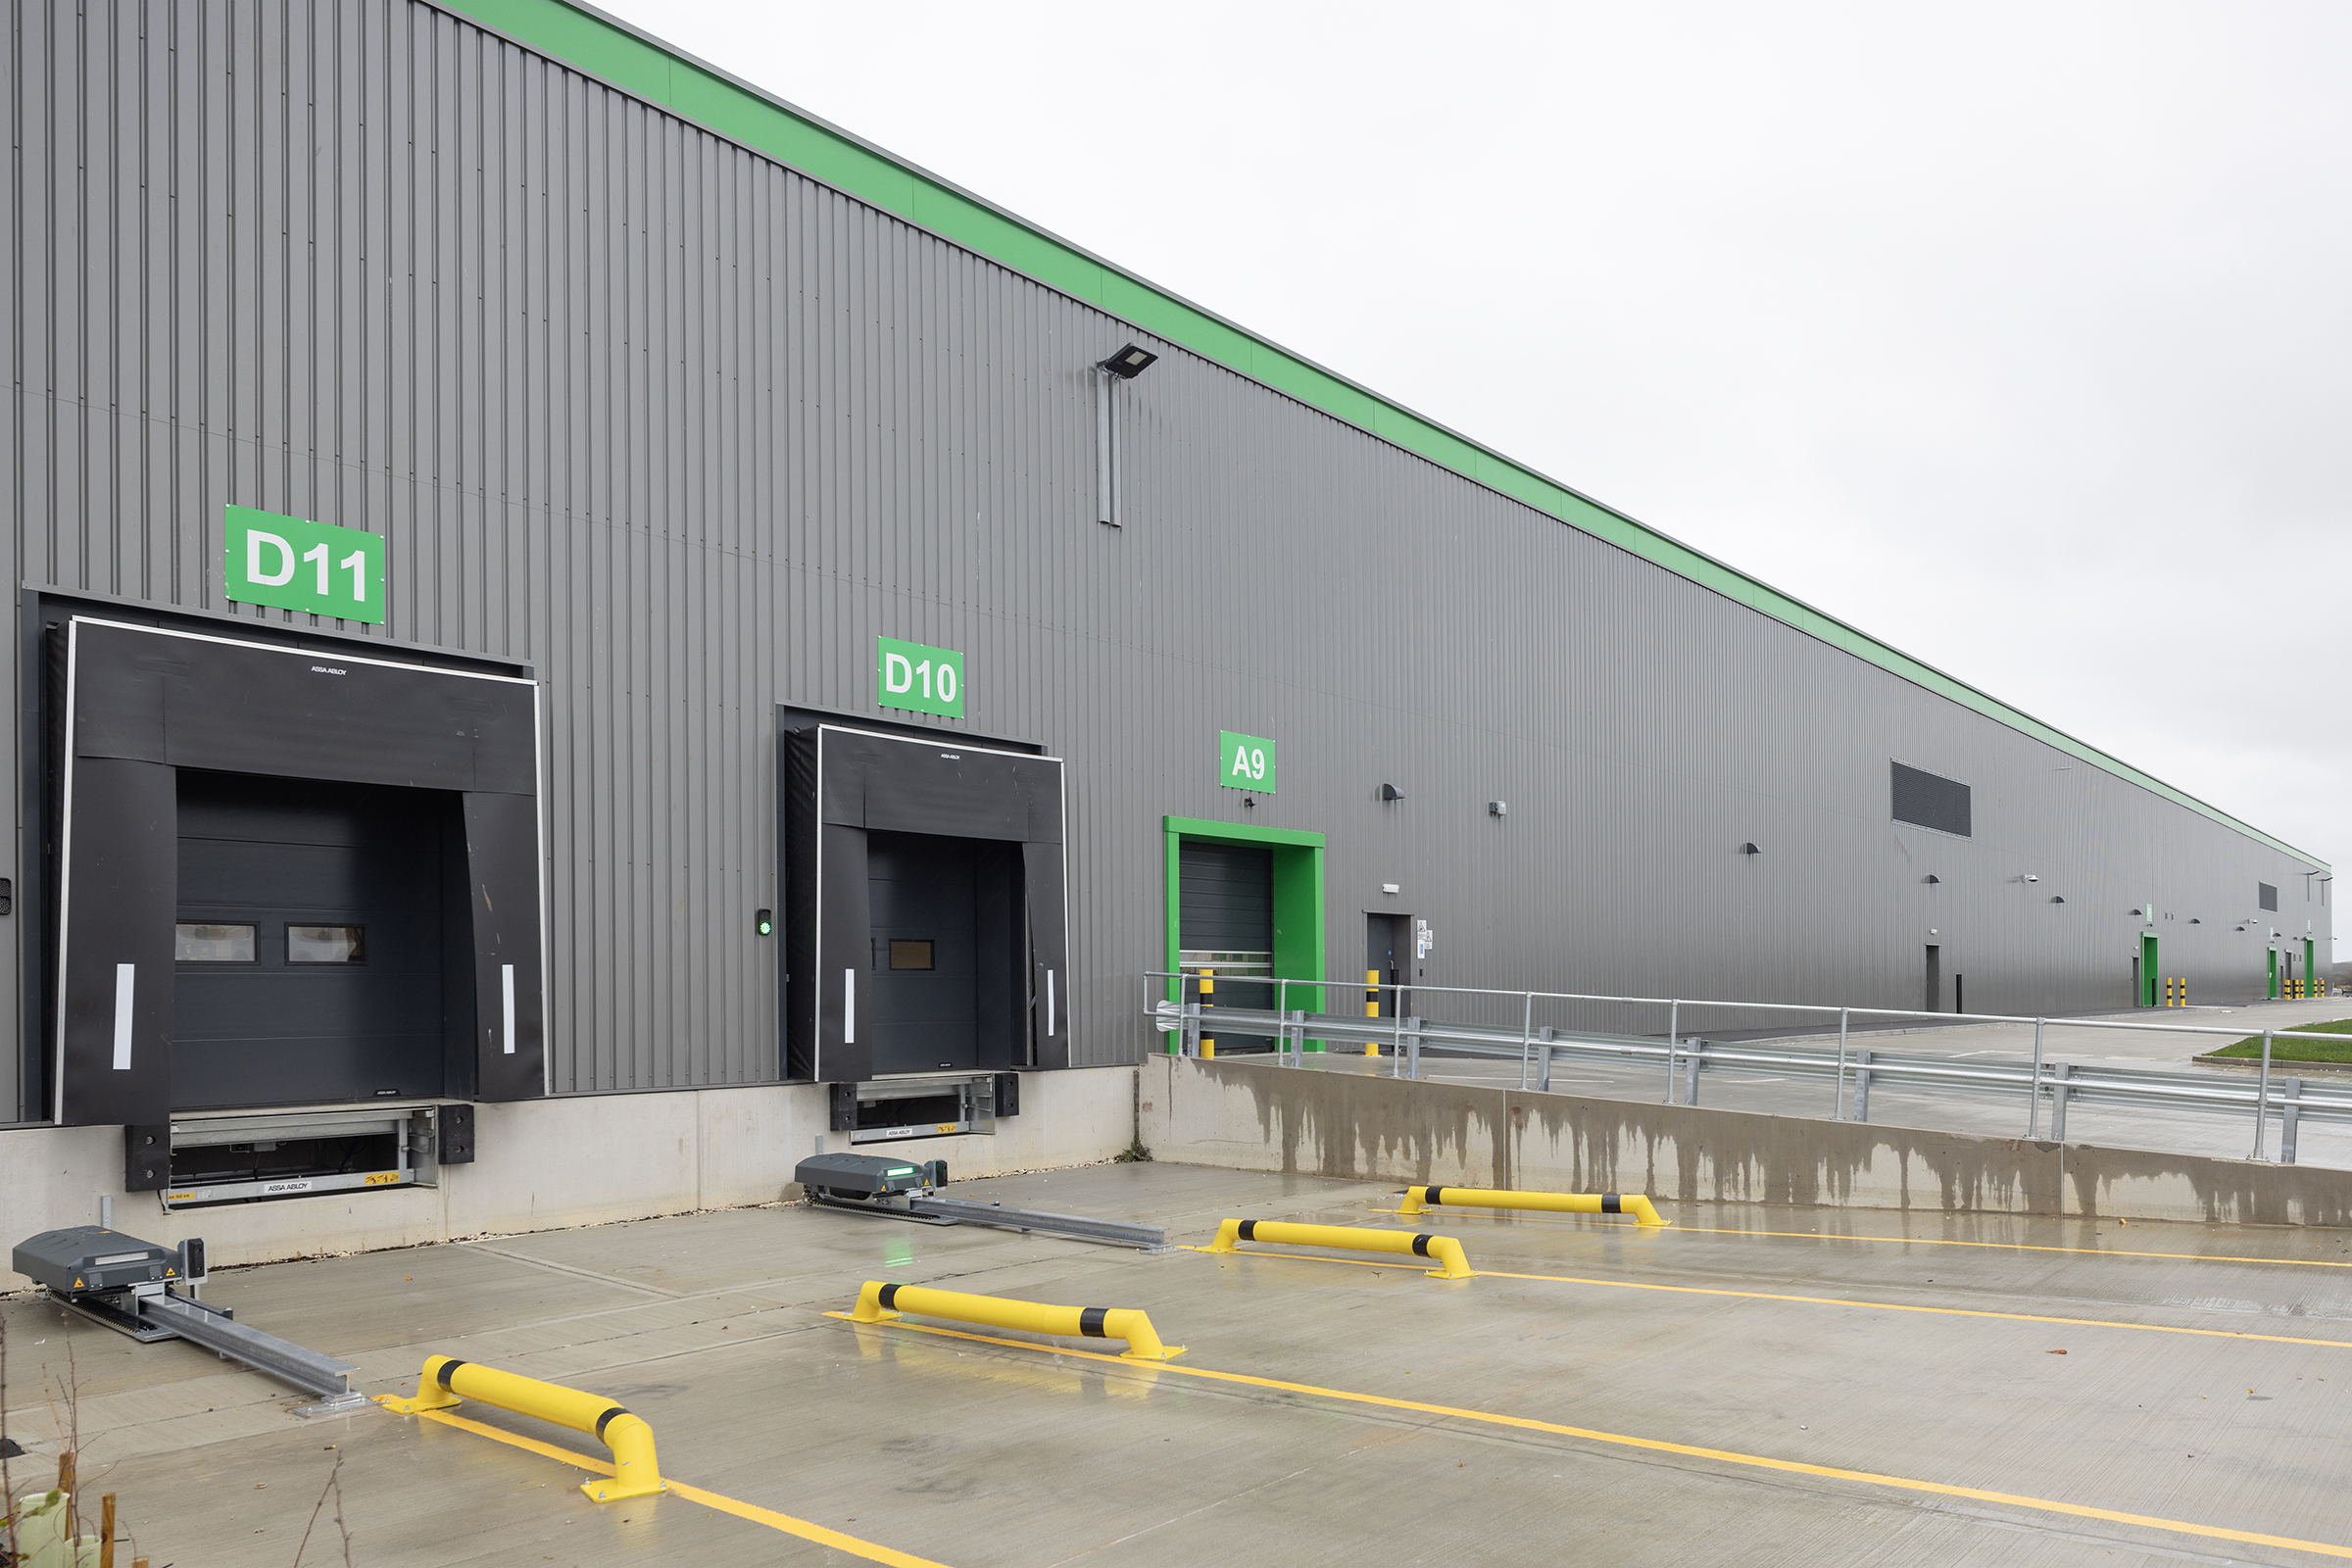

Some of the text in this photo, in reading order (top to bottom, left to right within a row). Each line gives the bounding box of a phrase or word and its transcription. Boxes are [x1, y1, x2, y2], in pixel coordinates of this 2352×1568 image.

[247, 528, 366, 602] D11
[327, 667, 347, 676] ABLOY
[886, 652, 956, 703] D10
[1232, 745, 1265, 780] A9
